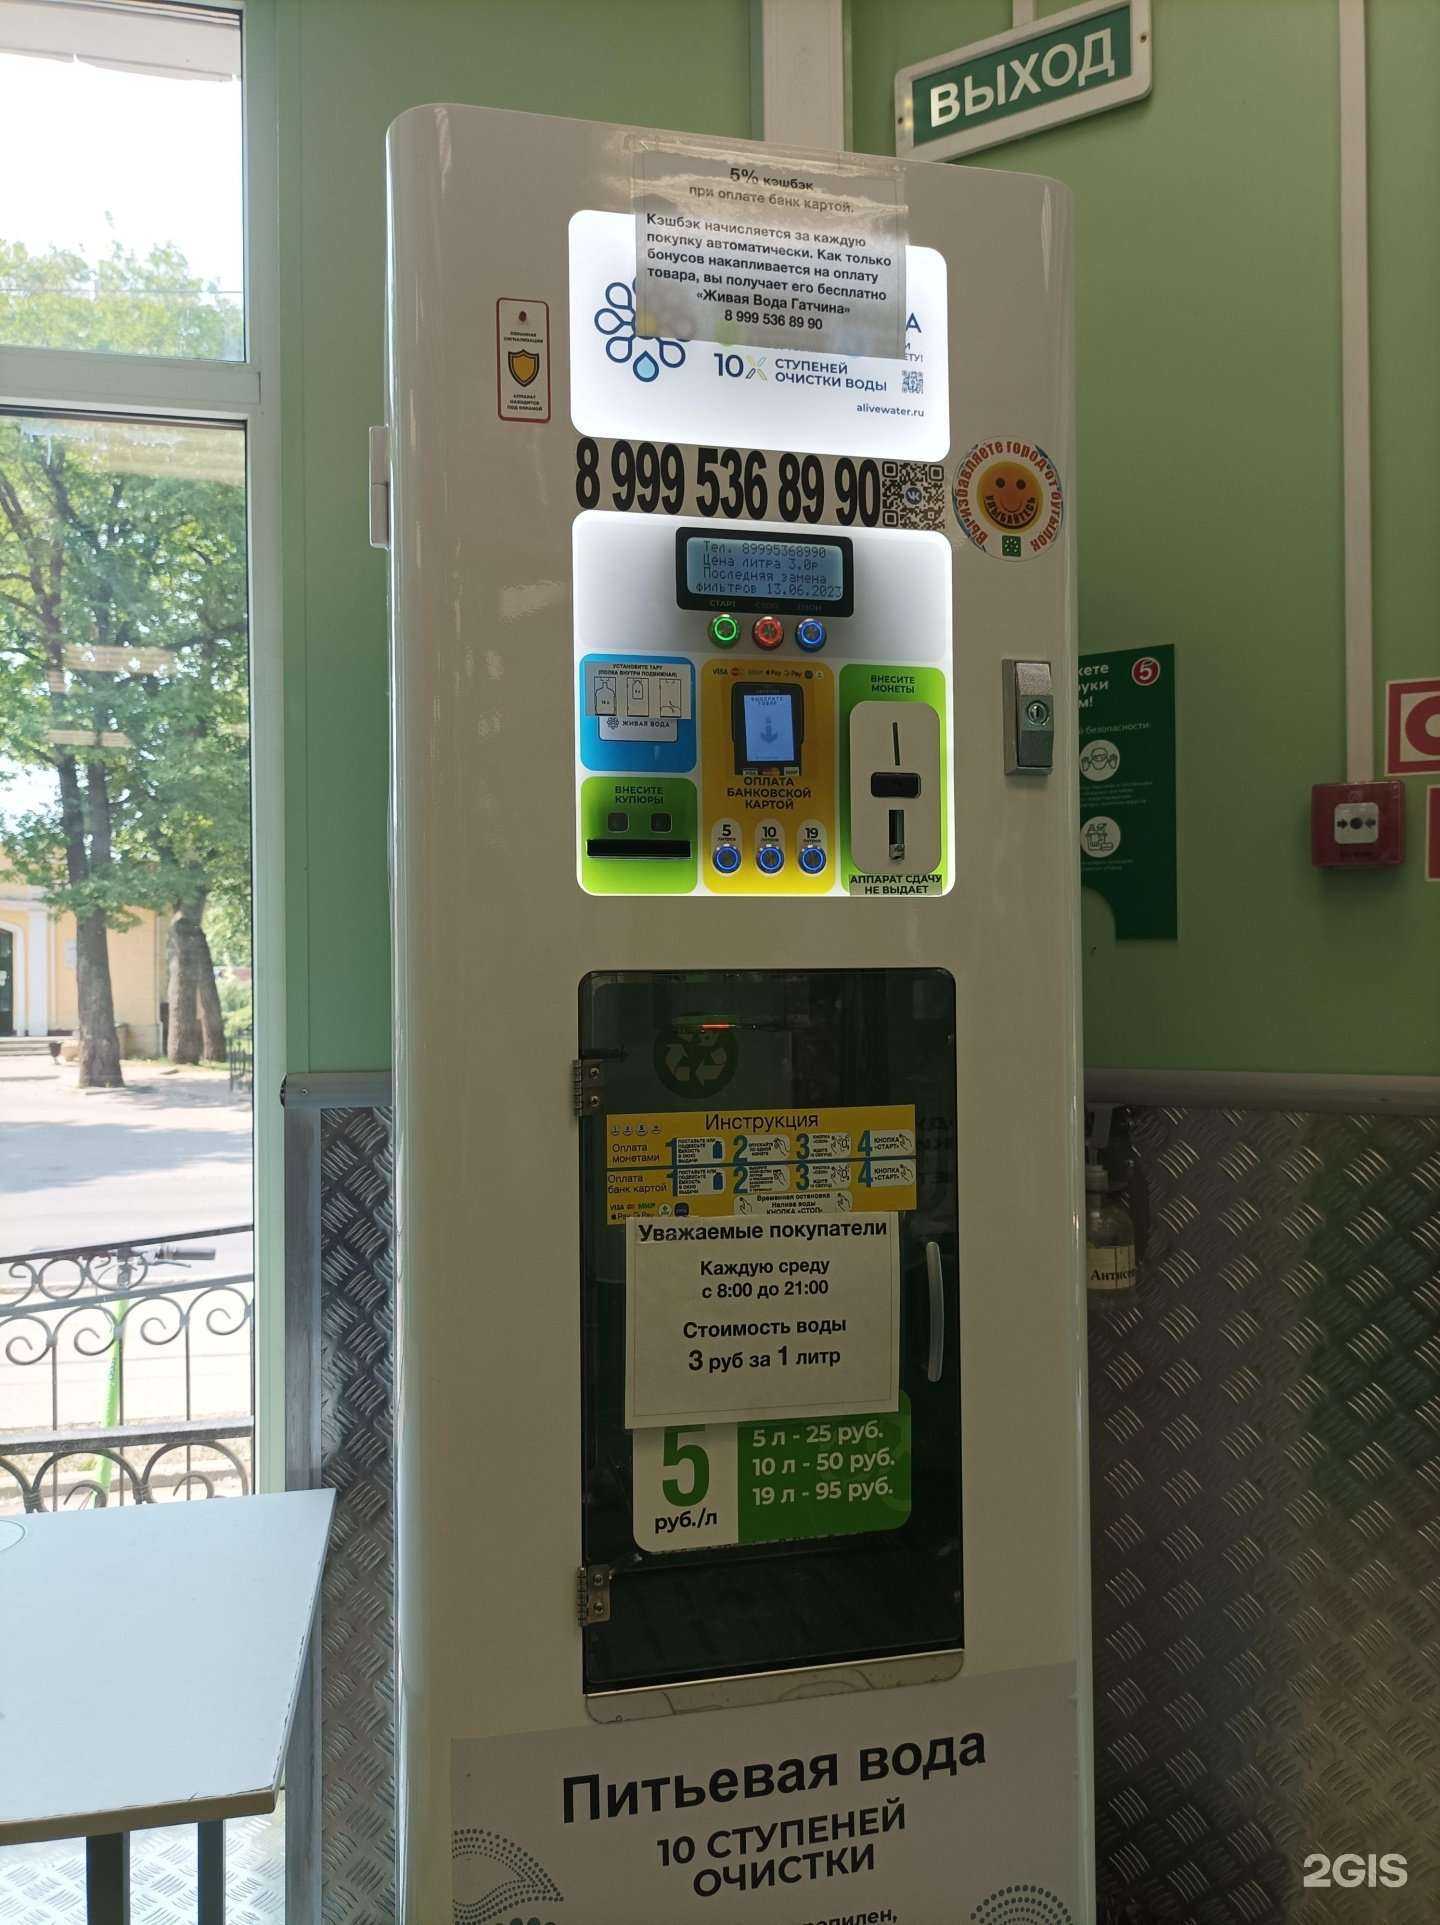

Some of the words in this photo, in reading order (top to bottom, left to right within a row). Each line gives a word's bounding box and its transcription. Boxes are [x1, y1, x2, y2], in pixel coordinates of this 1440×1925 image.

[930, 28, 1116, 128] ВЫХОД
[729, 167, 760, 185] 5%
[763, 175, 814, 191] кэшбэк
[689, 185, 715, 200] при
[718, 188, 766, 204] оплате
[768, 191, 800, 207] банк
[803, 197, 855, 214] картой.
[646, 213, 701, 230] Кэшбэк
[704, 221, 791, 240] начисляется
[795, 230, 811, 242] за
[813, 233, 867, 249] каждую
[646, 233, 703, 251] покупку
[706, 239, 813, 259] автоматически.
[817, 248, 843, 262] Как
[845, 253, 893, 268] только
[647, 248, 705, 265] бонусов
[708, 255, 811, 277] накапливается
[813, 266, 830, 277] на
[833, 269, 879, 285] оплату
[647, 267, 700, 284] товара,
[703, 273, 723, 284] вы
[725, 276, 788, 294] получает
[791, 281, 814, 295] его
[817, 282, 887, 301] бесплатно
[696, 289, 750, 307] «Живая
[753, 294, 788, 311] Вода
[791, 299, 851, 315] Гатчина»
[724, 310, 733, 322] 8
[736, 310, 759, 325] 999
[763, 312, 785, 327] 536
[789, 315, 804, 329] 89
[807, 316, 823, 330] 90
[775, 357, 848, 374] СТУПЕНЕЙ
[775, 371, 841, 388] ОЧИСТКИ
[845, 377, 887, 392] ВОДЫ
[856, 402, 925, 417] alivewater.ru
[575, 437, 600, 510] 8
[611, 440, 685, 515] 999
[696, 445, 768, 520] 536
[778, 452, 824, 524] 89
[834, 457, 881, 528] 90
[704, 541, 732, 554] Тел.
[742, 543, 826, 558] 89995368990
[703, 554, 735, 568] Цена
[743, 560, 781, 570] литра
[703, 567, 774, 583] Последняя
[782, 574, 827, 585] замена
[712, 668, 728, 676] VISA
[870, 675, 916, 685] ВНЕСИТЕ
[871, 685, 915, 694] МОНЕТЫ
[650, 721, 670, 729] ВОДА
[615, 786, 664, 795] ВНЕСИТЕ
[743, 776, 794, 787] ОПЛАТА
[615, 795, 664, 805] КУПЮРЫ
[727, 786, 811, 800] БАНКОВСКОЙ
[745, 798, 794, 810] КАРТОЙ
[722, 824, 732, 836] 5
[762, 826, 777, 838] 10
[805, 827, 819, 839] 19
[850, 874, 903, 885] АППАРАТ
[905, 874, 942, 886] СДАЧУ
[864, 886, 881, 895] НЕ
[883, 885, 929, 895] ВЫДАЕТ
[704, 1113, 819, 1133] Инструкция
[611, 1143, 648, 1153] Оплата
[733, 1135, 748, 1167] 2
[796, 1133, 810, 1159] 3
[857, 1130, 872, 1156] 4
[612, 1154, 660, 1164] монетами
[608, 1174, 644, 1183] Оплата
[733, 1166, 749, 1194] 2
[796, 1163, 810, 1190] 3
[858, 1159, 873, 1188] 4
[608, 1185, 632, 1194] банк
[633, 1184, 667, 1194] картой
[638, 1224, 764, 1243] Уважаемые
[769, 1221, 888, 1241] покупатели
[700, 1259, 773, 1278] Каждую
[778, 1258, 830, 1277] среду
[702, 1287, 712, 1299] с
[717, 1283, 752, 1298] 8:00
[757, 1285, 780, 1300] до
[784, 1280, 829, 1296] 21:00
[683, 1320, 791, 1339] Стоимость
[796, 1319, 847, 1336] воды
[688, 1350, 703, 1371] 3
[709, 1352, 743, 1374] руб
[749, 1355, 771, 1368] за
[777, 1346, 788, 1366] 1
[796, 1349, 841, 1369] литр
[752, 1430, 766, 1448] 5
[771, 1432, 786, 1447] л
[806, 1425, 832, 1443] 25
[838, 1420, 884, 1444] руб.
[662, 1424, 710, 1508] 5
[752, 1457, 776, 1476] 10
[781, 1459, 796, 1475] л
[816, 1453, 843, 1472] 50
[850, 1448, 895, 1474] руб.
[752, 1487, 775, 1506] 19
[780, 1487, 795, 1503] л
[816, 1482, 842, 1500] 95
[849, 1477, 894, 1502] руб.
[654, 1509, 718, 1534] руб./л
[562, 1752, 839, 1824] Питьевая
[859, 1731, 986, 1783] вода
[656, 1836, 696, 1867] 10
[707, 1796, 907, 1860] СТУПЕНЕЙ
[692, 1843, 876, 1898] ОЧИСТКИ
